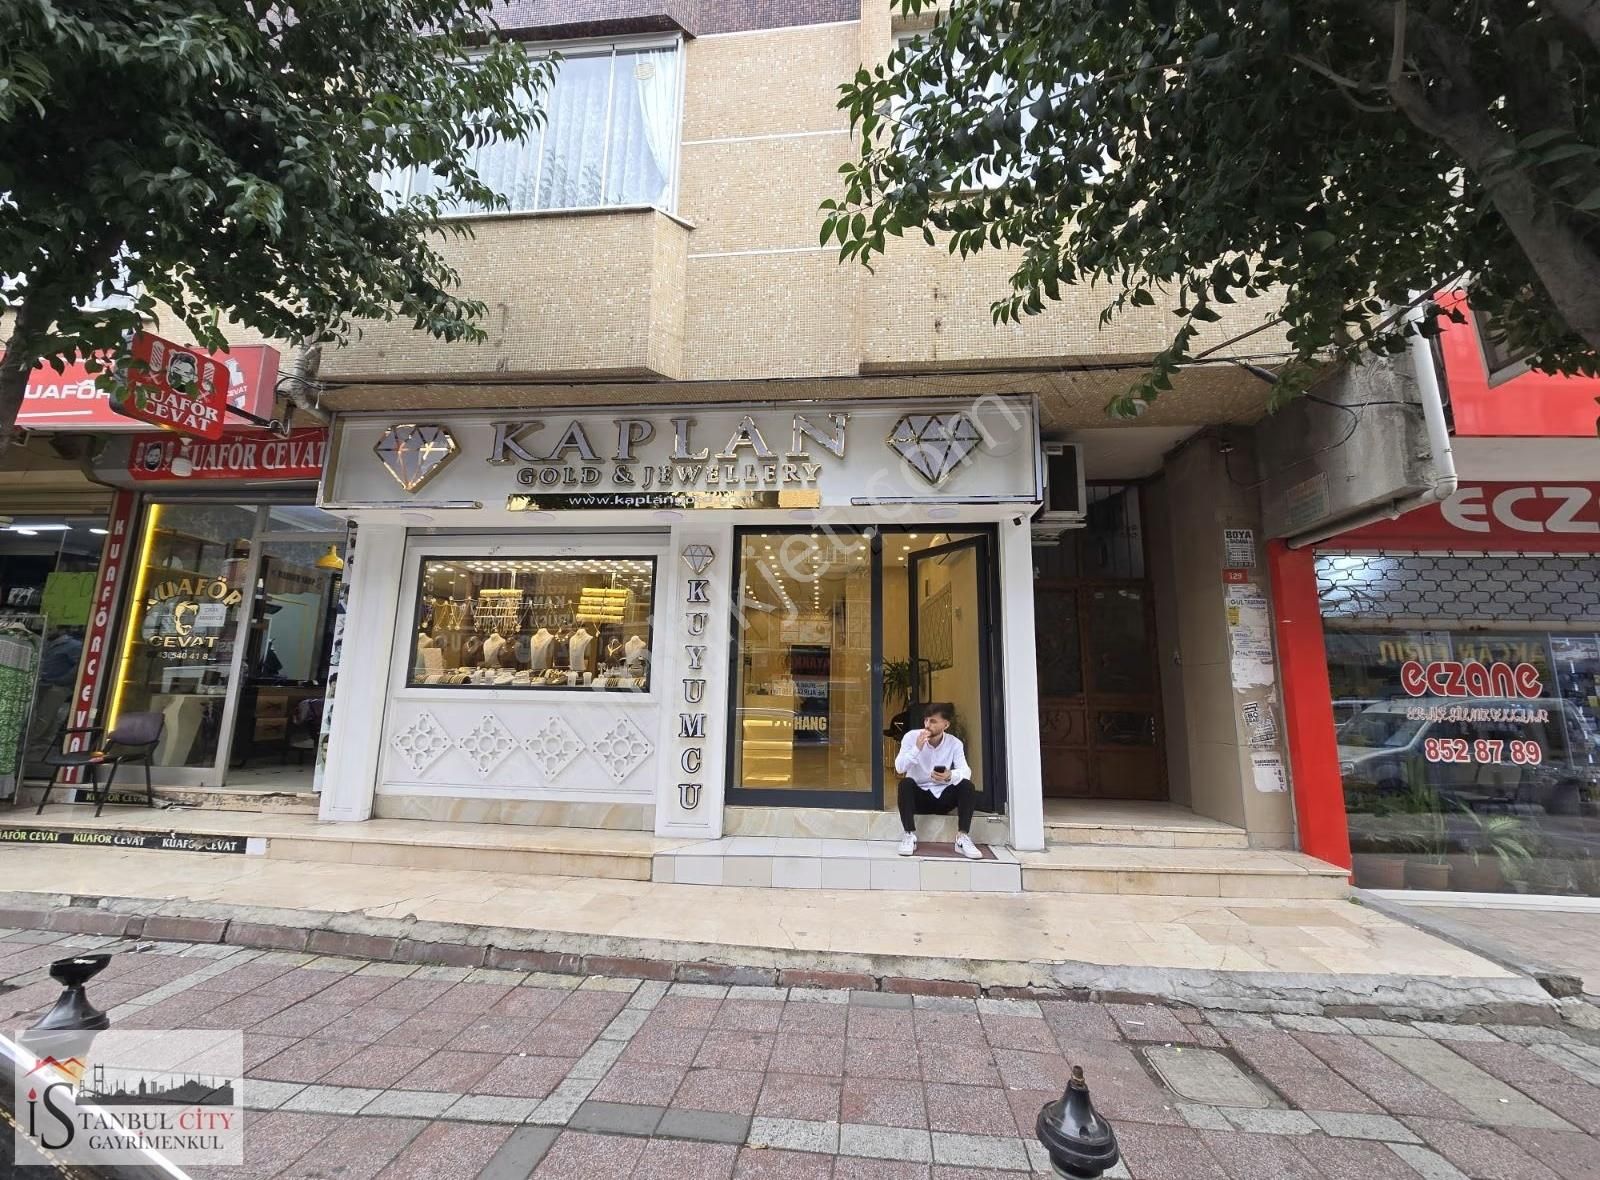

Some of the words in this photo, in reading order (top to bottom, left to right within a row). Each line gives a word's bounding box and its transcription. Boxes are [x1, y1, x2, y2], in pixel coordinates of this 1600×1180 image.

[23, 380, 111, 399] UAFÖ
[143, 400, 212, 431] CEVAT
[486, 413, 850, 463] KAPLAN
[516, 466, 601, 485] GOLD
[612, 465, 635, 484] &
[641, 463, 821, 490] JEWELLERY
[1440, 487, 1600, 533] ECZ
[1226, 530, 1251, 539] BOYA
[91, 520, 124, 653] KUAFÖR
[149, 635, 219, 648] CEVAT
[677, 579, 710, 811] KUYUMCU
[1400, 660, 1544, 699] eczane
[65, 658, 97, 782] CEVAT
[1425, 737, 1471, 763] 852
[1473, 739, 1504, 764] 87
[1510, 740, 1542, 765] 89
[29, 831, 59, 842] CEVAT
